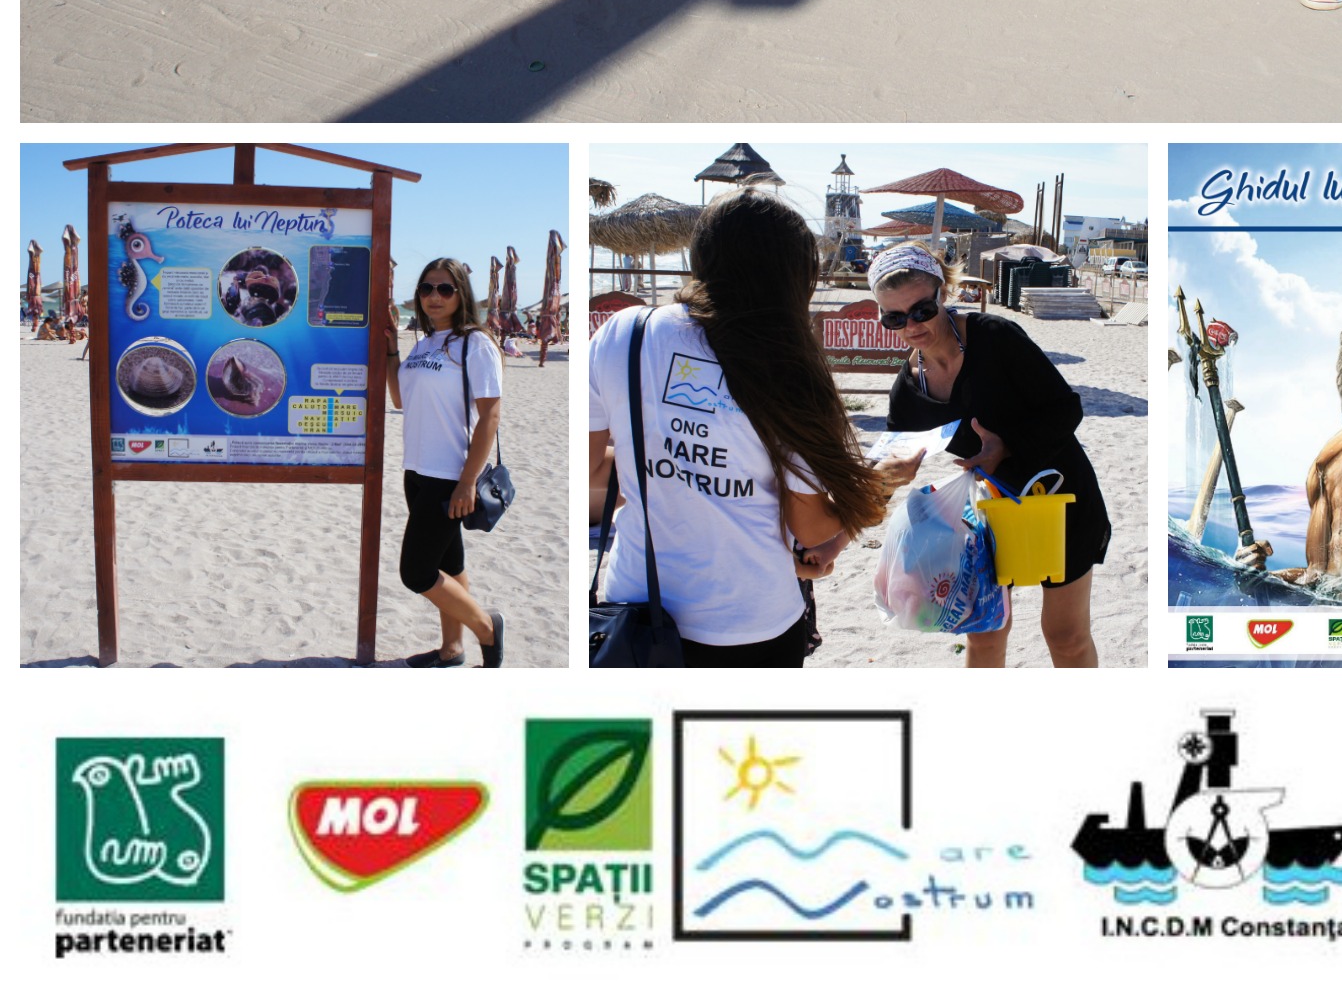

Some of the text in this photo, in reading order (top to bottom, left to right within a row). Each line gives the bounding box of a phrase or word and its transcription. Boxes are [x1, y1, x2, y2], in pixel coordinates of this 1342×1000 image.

[1197, 169, 1308, 216] Ghidul
[157, 206, 326, 235] Poteca lui Neptun
[670, 418, 709, 438] ONG
[1253, 624, 1278, 635] MOL
